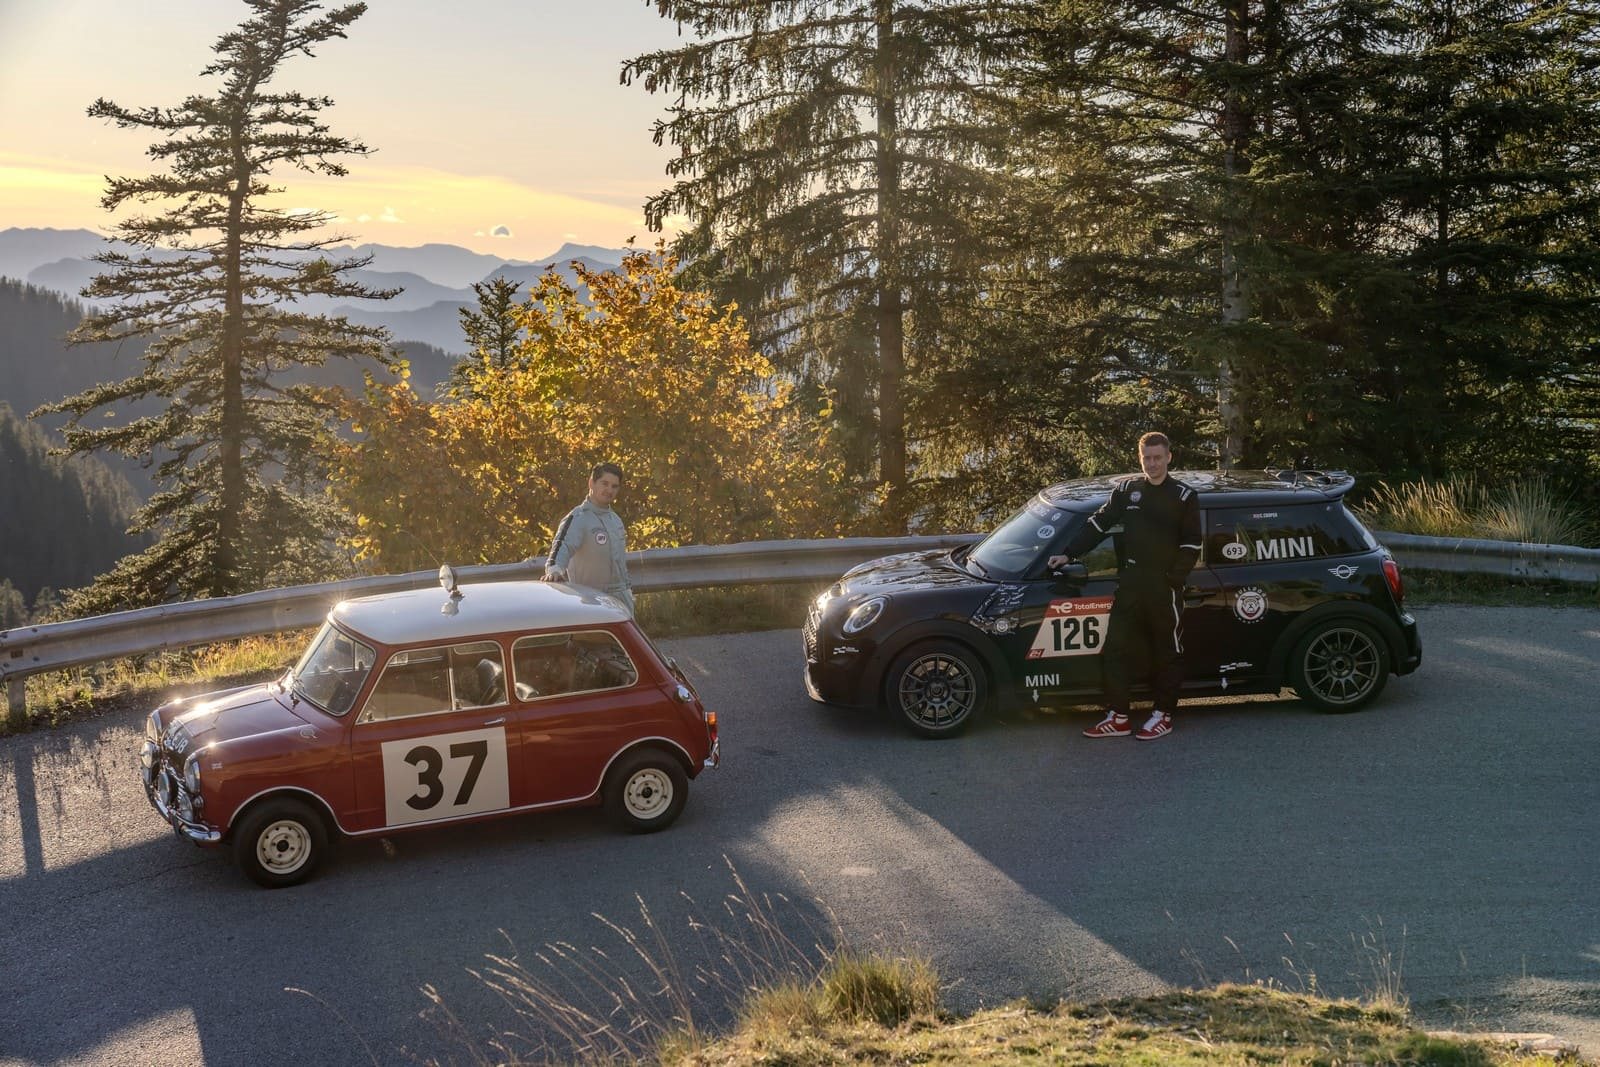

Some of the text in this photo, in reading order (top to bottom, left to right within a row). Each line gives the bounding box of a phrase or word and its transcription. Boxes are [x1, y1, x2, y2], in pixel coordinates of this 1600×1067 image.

[1226, 547, 1243, 556] 693
[1256, 536, 1314, 560] MINI
[1051, 616, 1100, 651] 126
[1025, 673, 1060, 688] MINI
[404, 740, 488, 811] 37
